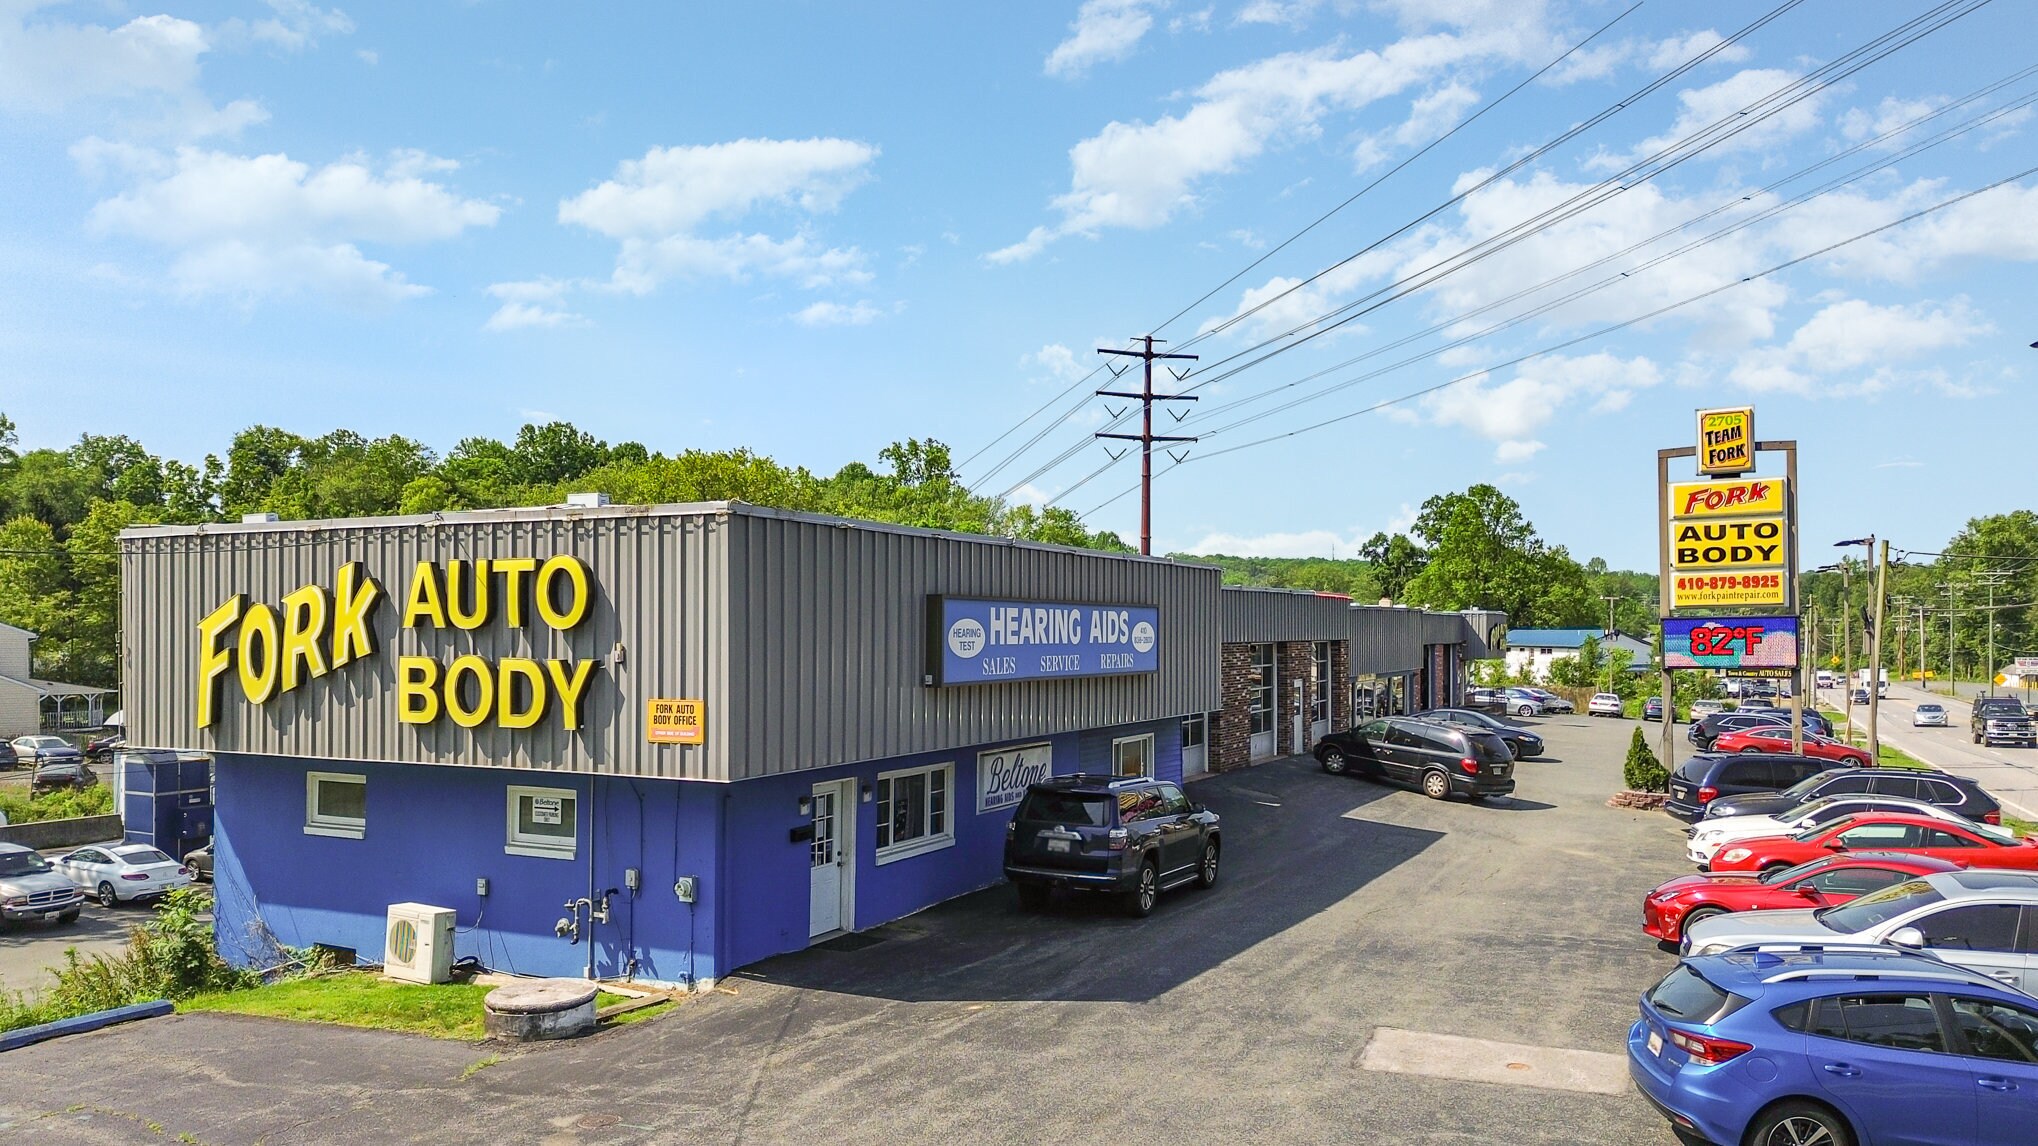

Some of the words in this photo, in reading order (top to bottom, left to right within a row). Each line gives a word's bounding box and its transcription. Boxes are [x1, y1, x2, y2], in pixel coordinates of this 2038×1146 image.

[1708, 415, 1742, 427] 2705
[1705, 425, 1742, 447] TEAM
[1709, 443, 1746, 466] FORK
[1684, 482, 1770, 514] FORK
[1678, 522, 1779, 543] AUTO
[1677, 544, 1779, 564] BODY
[402, 554, 593, 630] AUTO
[1677, 575, 1779, 590] 410-879-8925
[1677, 590, 1779, 602] www.forkpaintrepair.com
[953, 628, 981, 638] HEARING
[990, 607, 1081, 646] HEARING
[1089, 610, 1129, 645] AIDS
[197, 560, 383, 729] FORK
[959, 640, 976, 651] TEST
[1690, 626, 1765, 656] 82°F
[982, 657, 1016, 675] SALES
[1040, 654, 1080, 672] SERVICE
[1100, 653, 1134, 669] REPAIRS
[398, 654, 600, 731] BODY
[656, 704, 673, 713] FORK
[676, 705, 695, 714] AUTO
[653, 715, 671, 725] BODY
[674, 715, 697, 725] OFFICE
[987, 753, 1047, 795] Beltone
